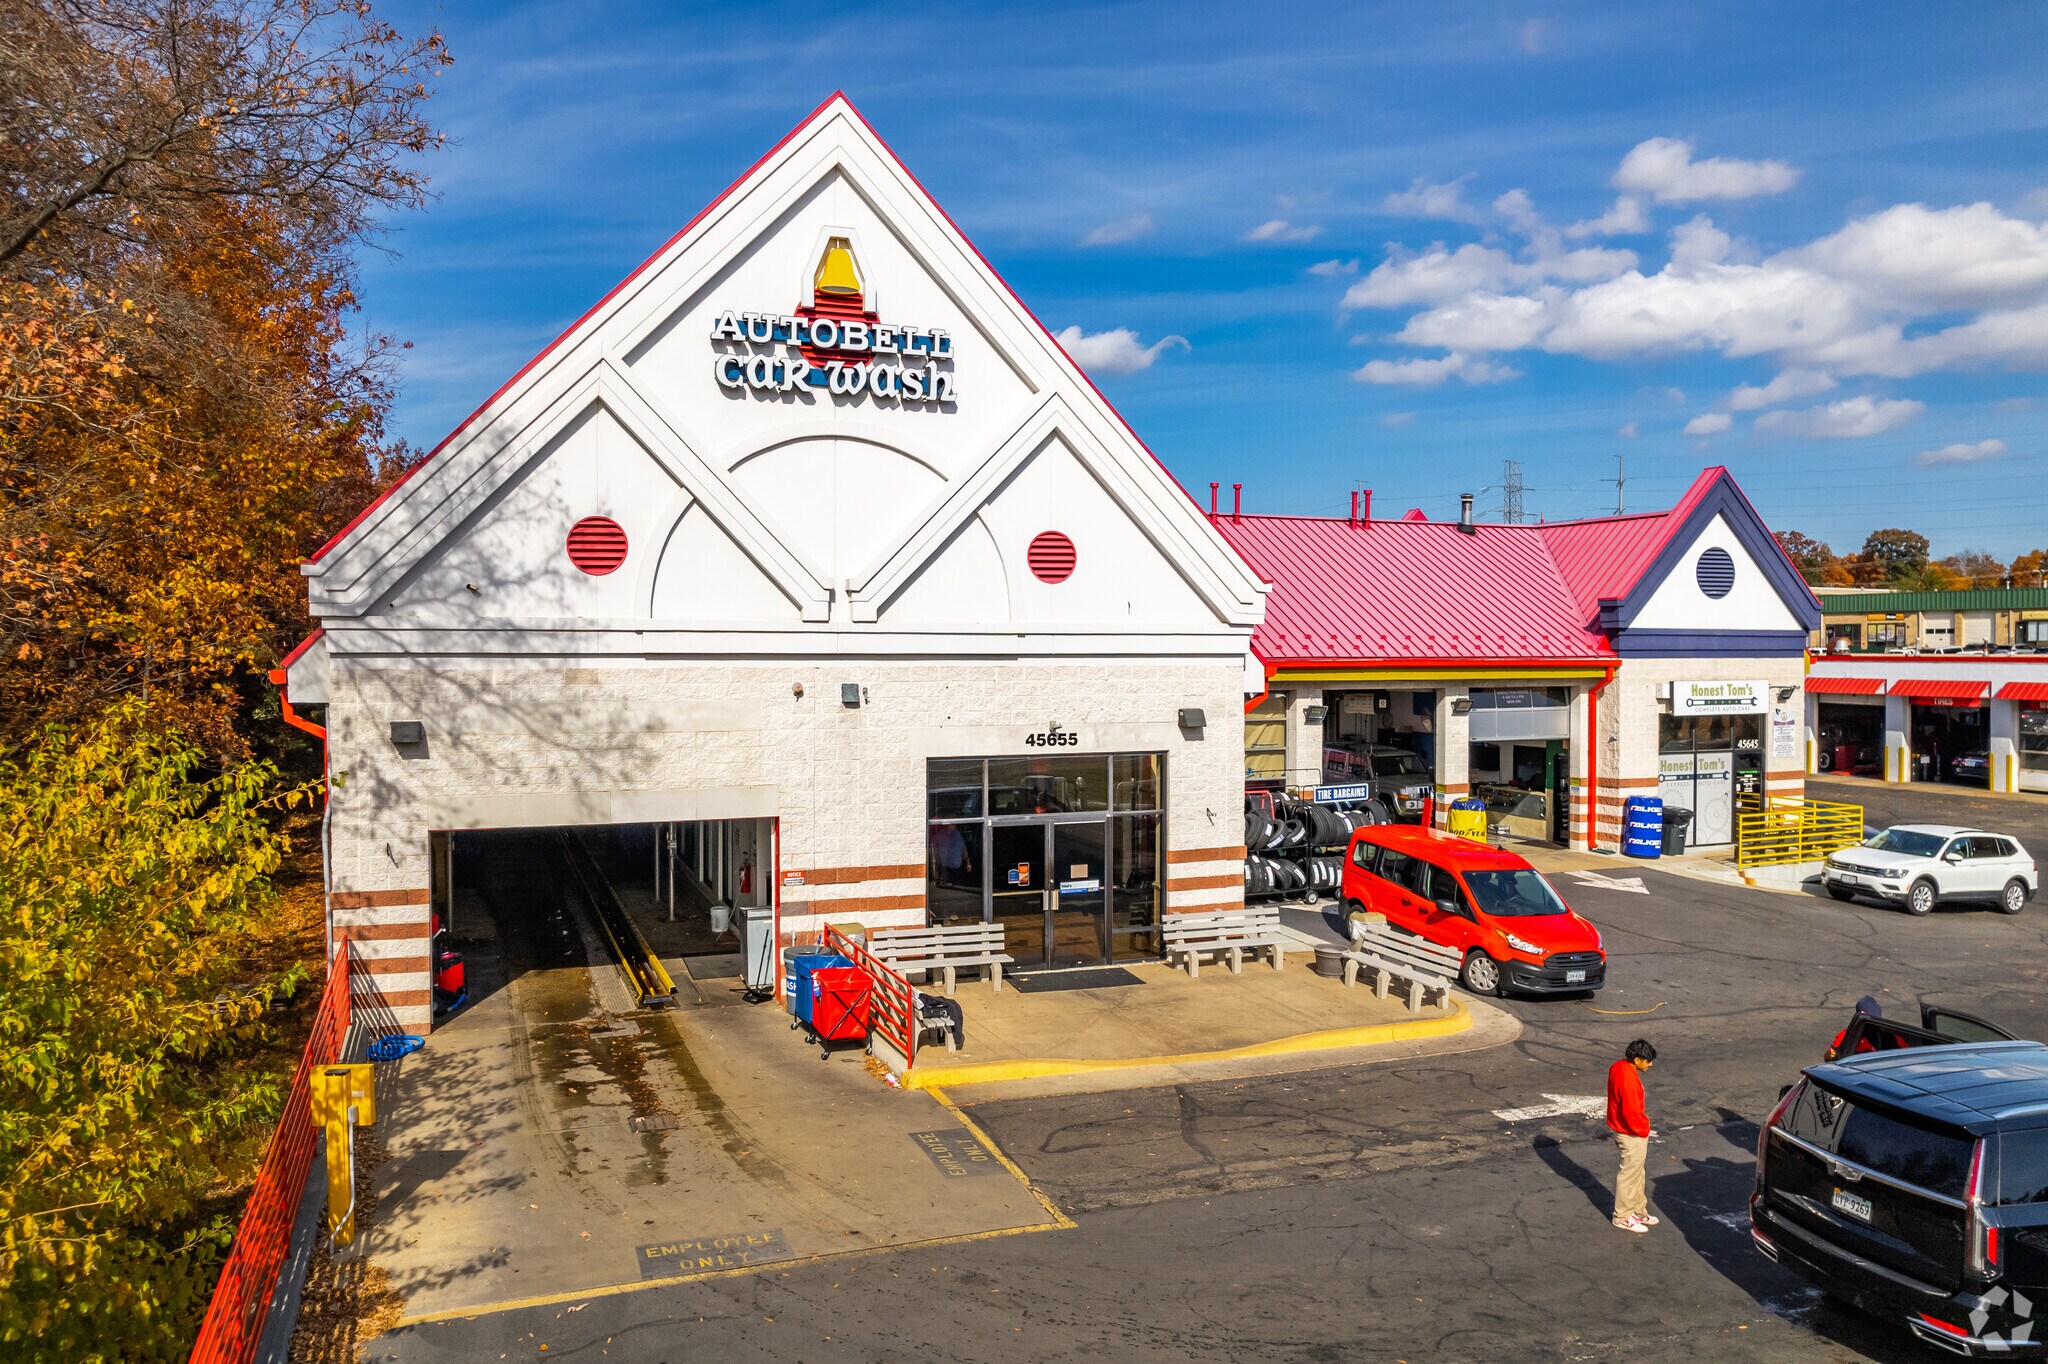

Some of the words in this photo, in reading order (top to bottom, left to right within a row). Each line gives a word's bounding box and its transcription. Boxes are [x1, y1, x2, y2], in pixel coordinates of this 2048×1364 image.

[710, 310, 954, 359] AUTOBELL
[1691, 684, 1724, 697] Honest
[1726, 683, 1753, 696] Tom's
[1933, 697, 1953, 706] TIRES
[1025, 733, 1078, 747] 45655
[1737, 739, 1758, 749] 45645
[1660, 760, 1693, 772] Honest
[1698, 758, 1725, 770] Tom's
[1317, 790, 1332, 800] TIRE
[1333, 787, 1366, 799] BARGAINS
[917, 1133, 968, 1176] EMPLOYEE
[955, 1139, 989, 1162] ONLY
[645, 1232, 778, 1258] EMPLOYEE
[679, 1251, 749, 1270] ONLY
